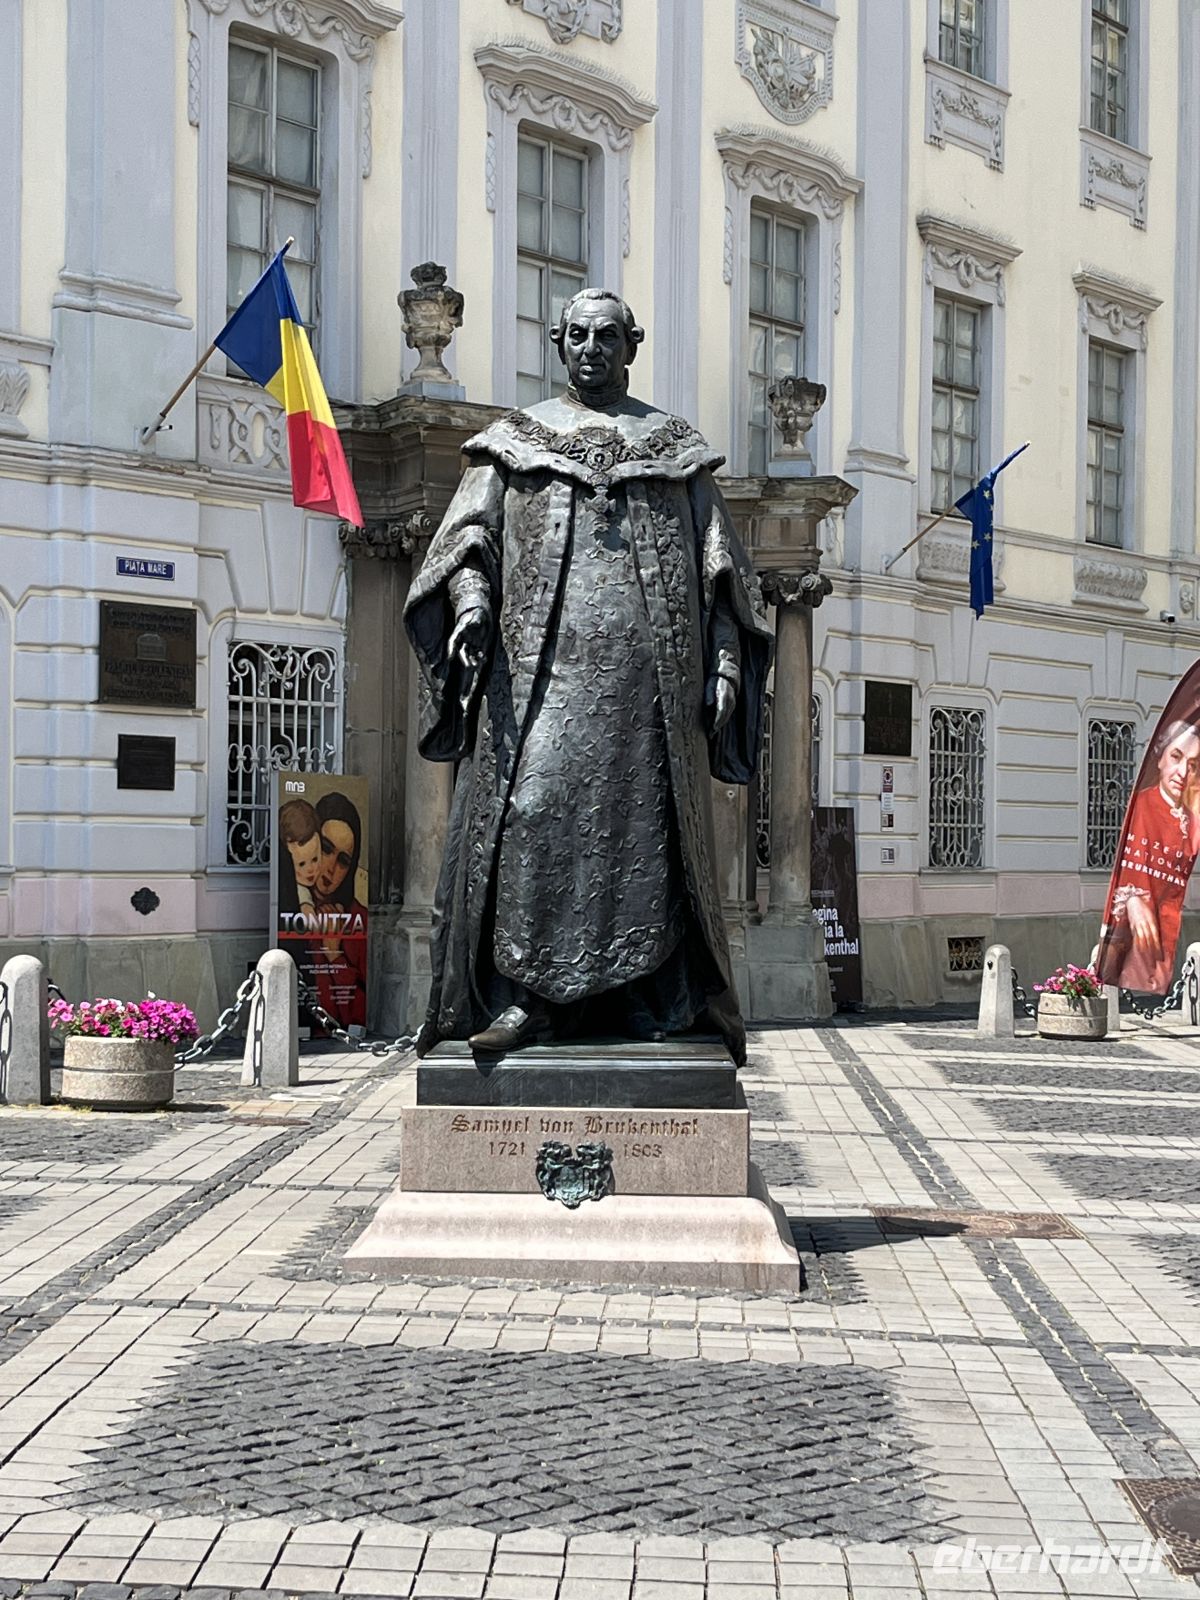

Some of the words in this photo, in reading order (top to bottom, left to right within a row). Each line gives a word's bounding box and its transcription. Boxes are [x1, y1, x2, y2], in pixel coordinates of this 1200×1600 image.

[147, 563, 167, 575] MARE
[1127, 833, 1192, 862] MUZEUL
[1121, 859, 1185, 887] BRUKENTHAL
[280, 912, 365, 935] TONITZA
[812, 904, 838, 925] egina
[834, 921, 844, 938] la
[823, 938, 859, 956] kenthal
[451, 1114, 530, 1135] Samuel
[539, 1118, 574, 1135] von
[584, 1115, 700, 1137] Brukenthal
[488, 1141, 525, 1156] 1721
[623, 1143, 663, 1158] 1803
